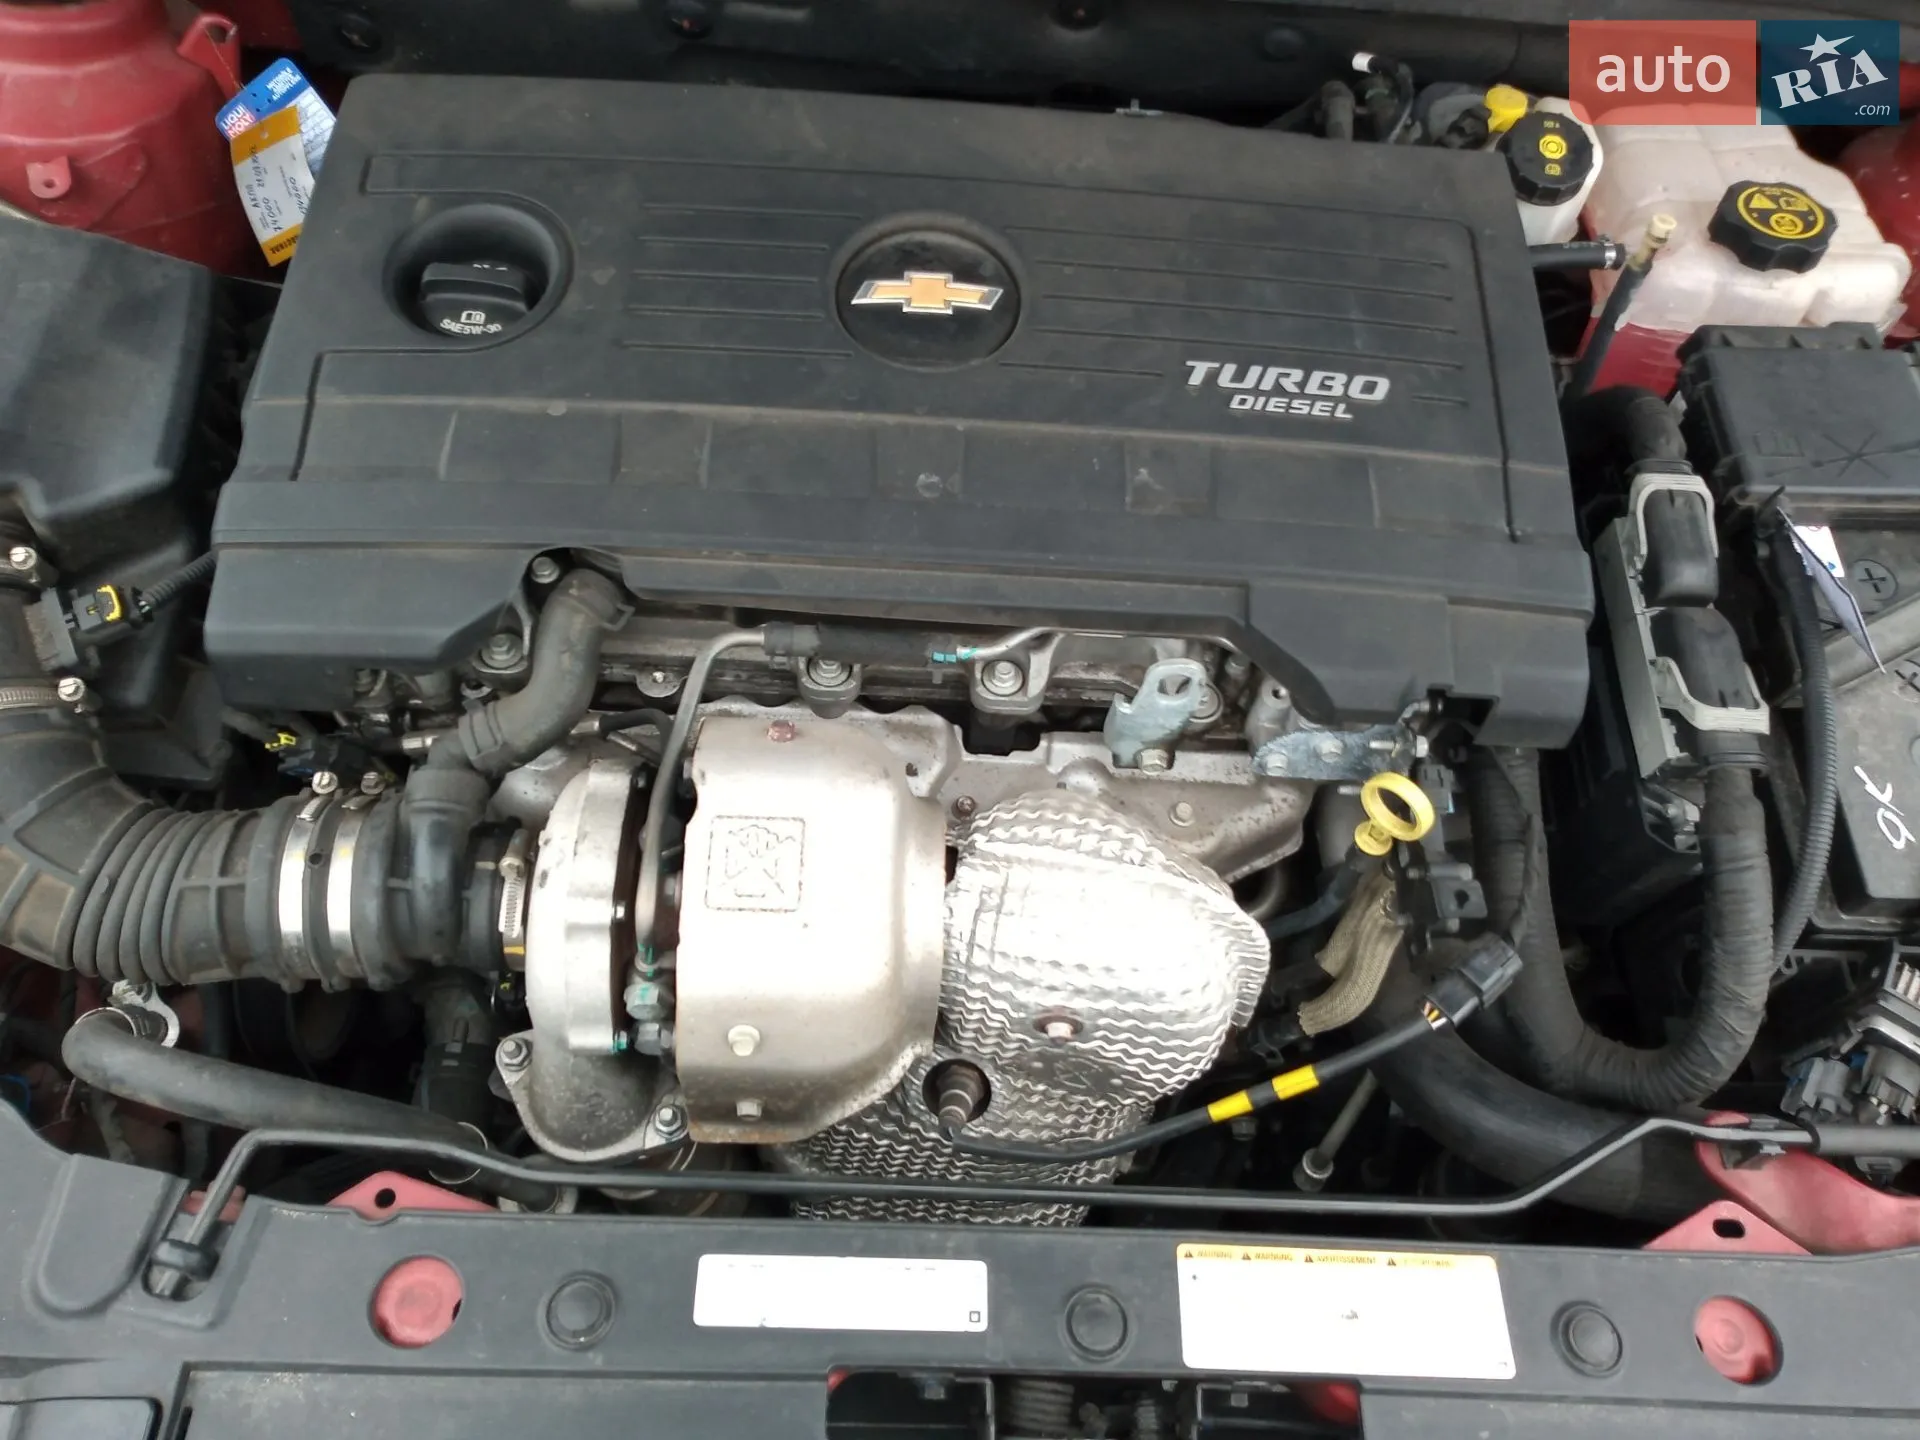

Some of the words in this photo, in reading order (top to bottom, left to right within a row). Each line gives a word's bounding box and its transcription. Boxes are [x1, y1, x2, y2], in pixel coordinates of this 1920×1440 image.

[222, 104, 246, 131] LIQUI
[228, 112, 255, 138] MOLY
[1185, 360, 1391, 402] TURBO
[1229, 394, 1354, 420] DIESEL
